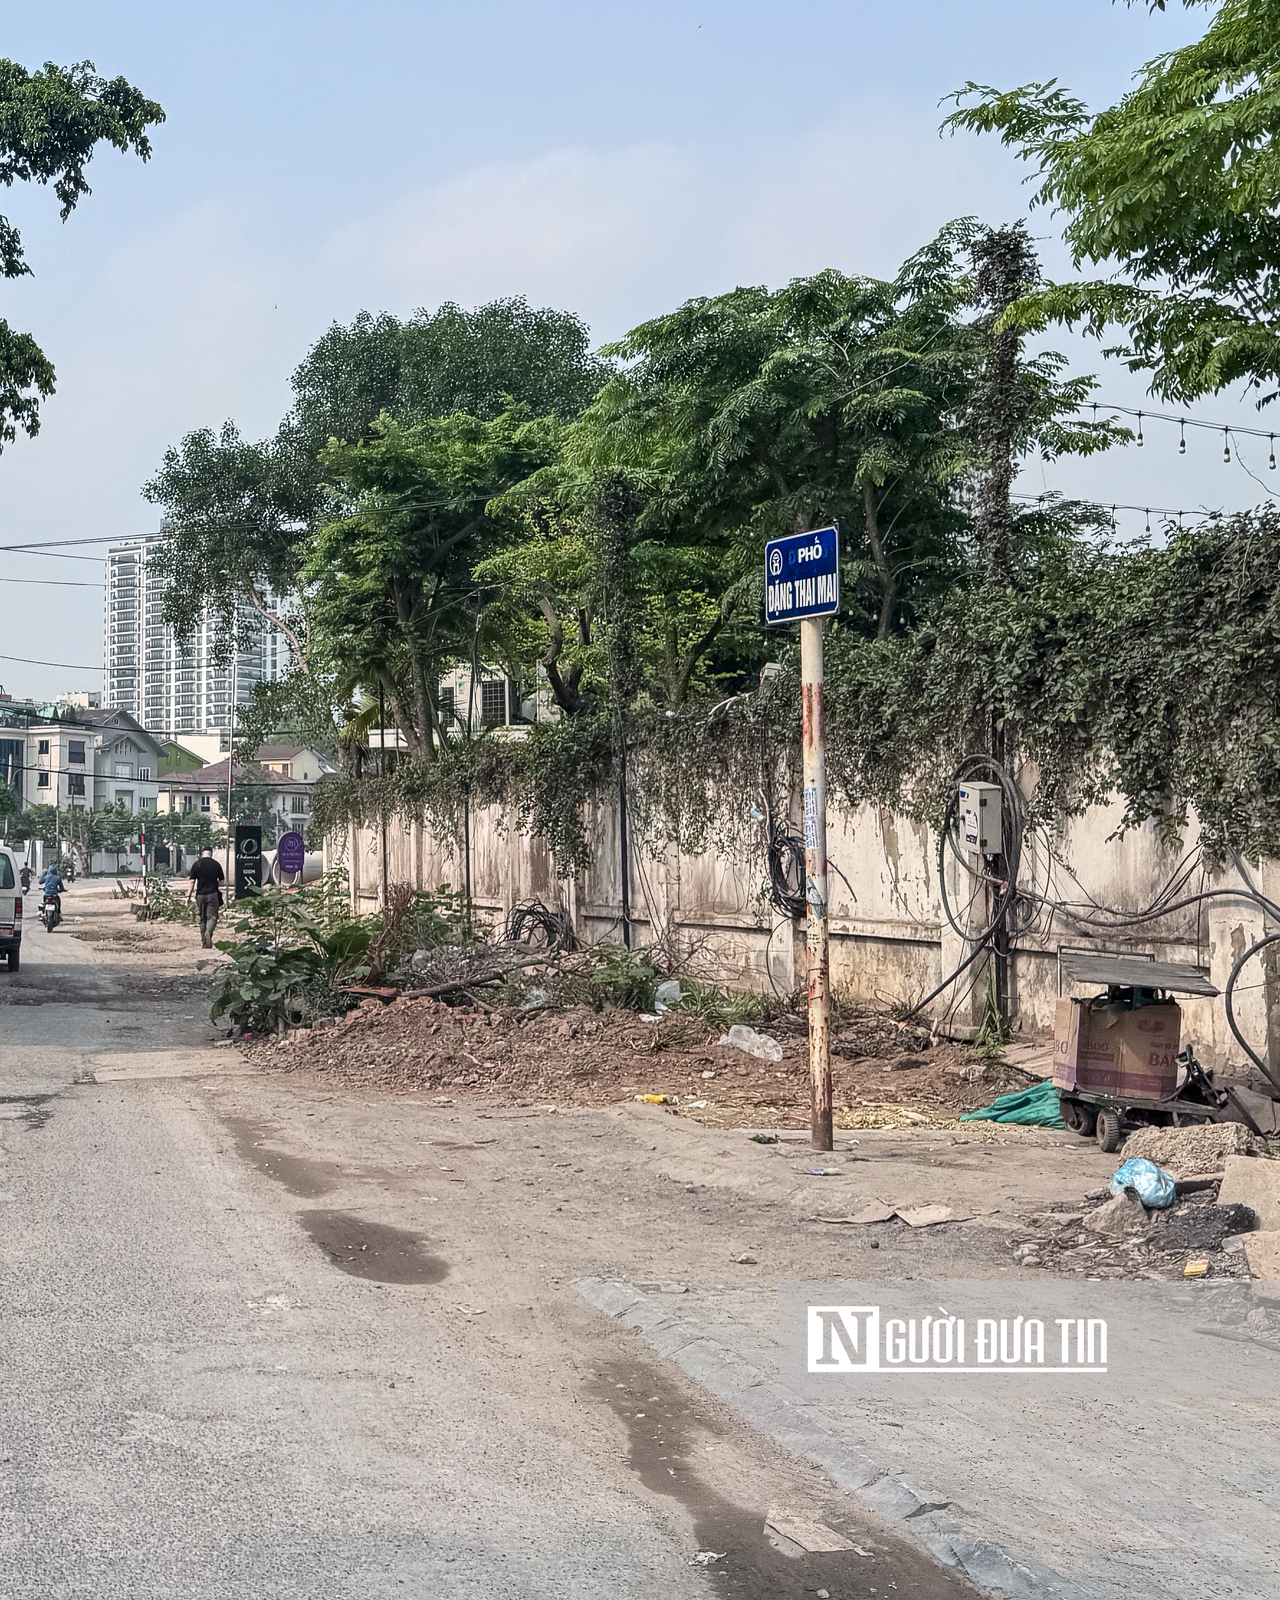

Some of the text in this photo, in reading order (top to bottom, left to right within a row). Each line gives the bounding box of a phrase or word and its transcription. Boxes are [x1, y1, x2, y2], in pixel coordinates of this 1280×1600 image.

[798, 536, 822, 563] PHỐ
[768, 573, 836, 616] ĐẶNG THAI MAI
